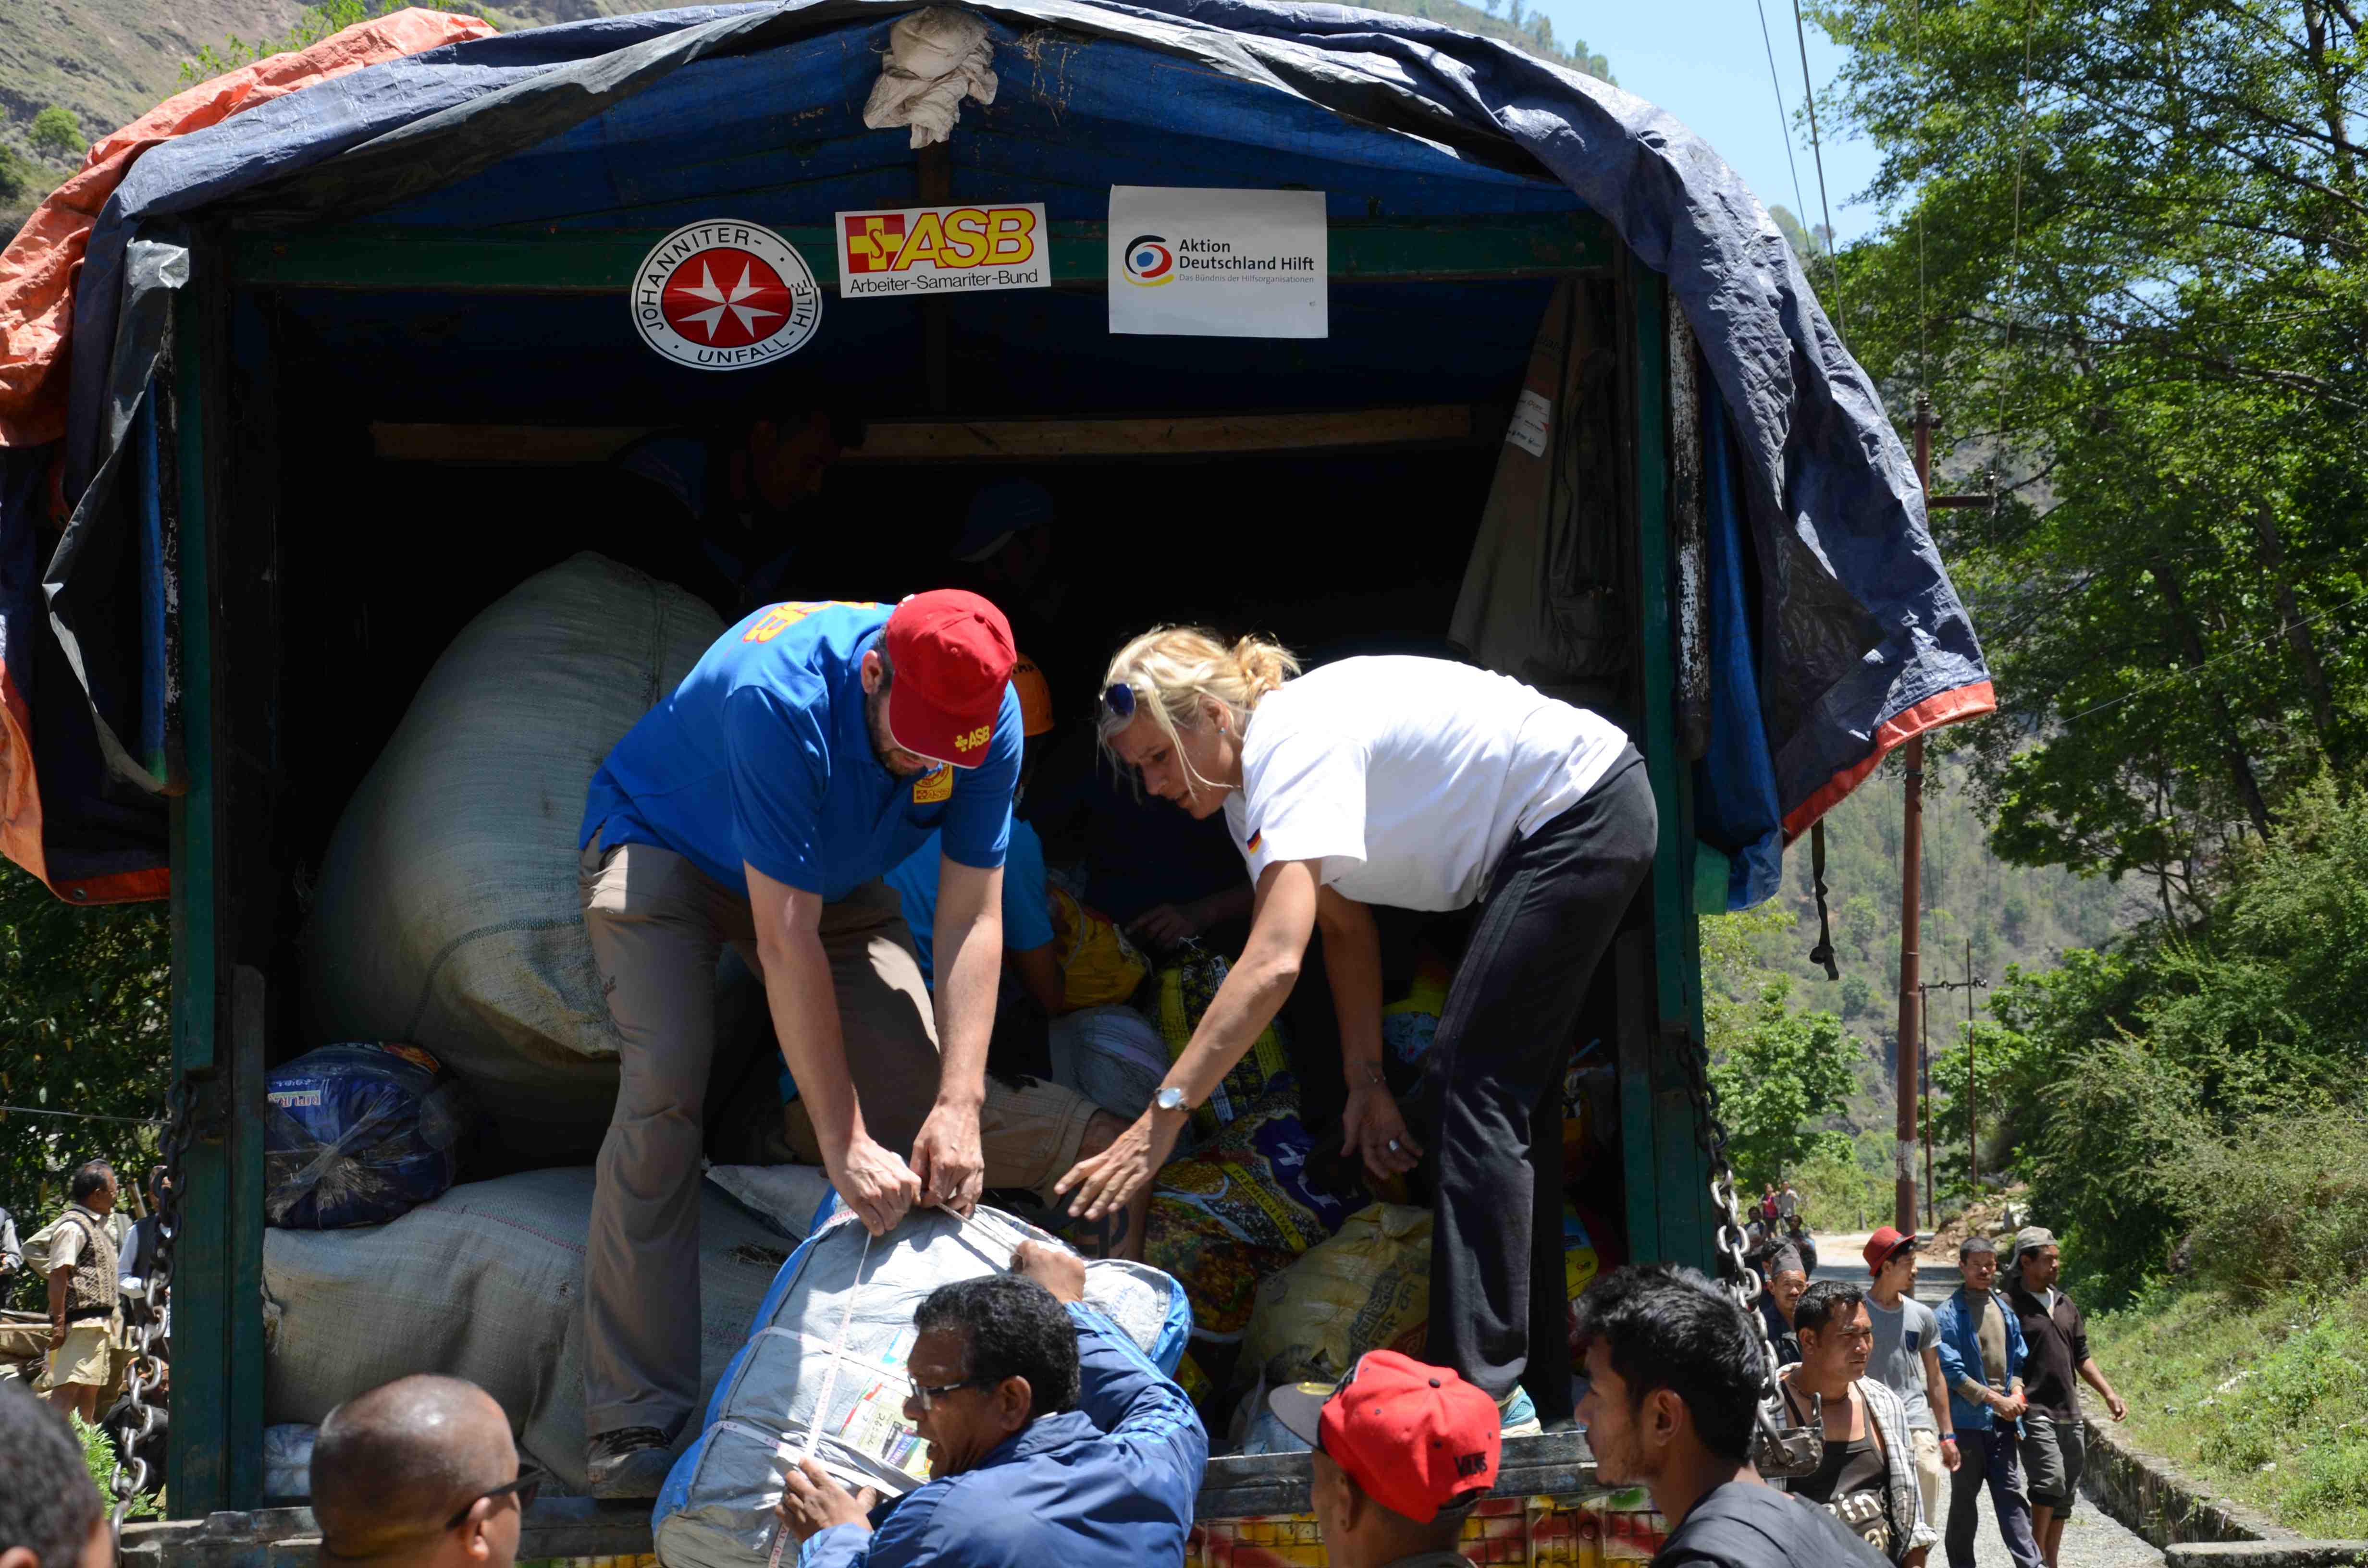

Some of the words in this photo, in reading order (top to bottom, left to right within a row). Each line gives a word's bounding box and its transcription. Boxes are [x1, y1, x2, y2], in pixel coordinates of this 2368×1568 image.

[891, 208, 1036, 271] ASB
[1179, 238, 1231, 253] Aktion
[1179, 256, 1276, 270] Deutschland
[1281, 256, 1315, 270] Hilft
[640, 227, 763, 331] JOHANNITER-
[850, 269, 1038, 294] Arbeiter-Samariter-Bund
[1195, 273, 1226, 282] Bündnis
[1242, 274, 1314, 284] Hilfsorganisationen
[968, 725, 990, 749] ASB
